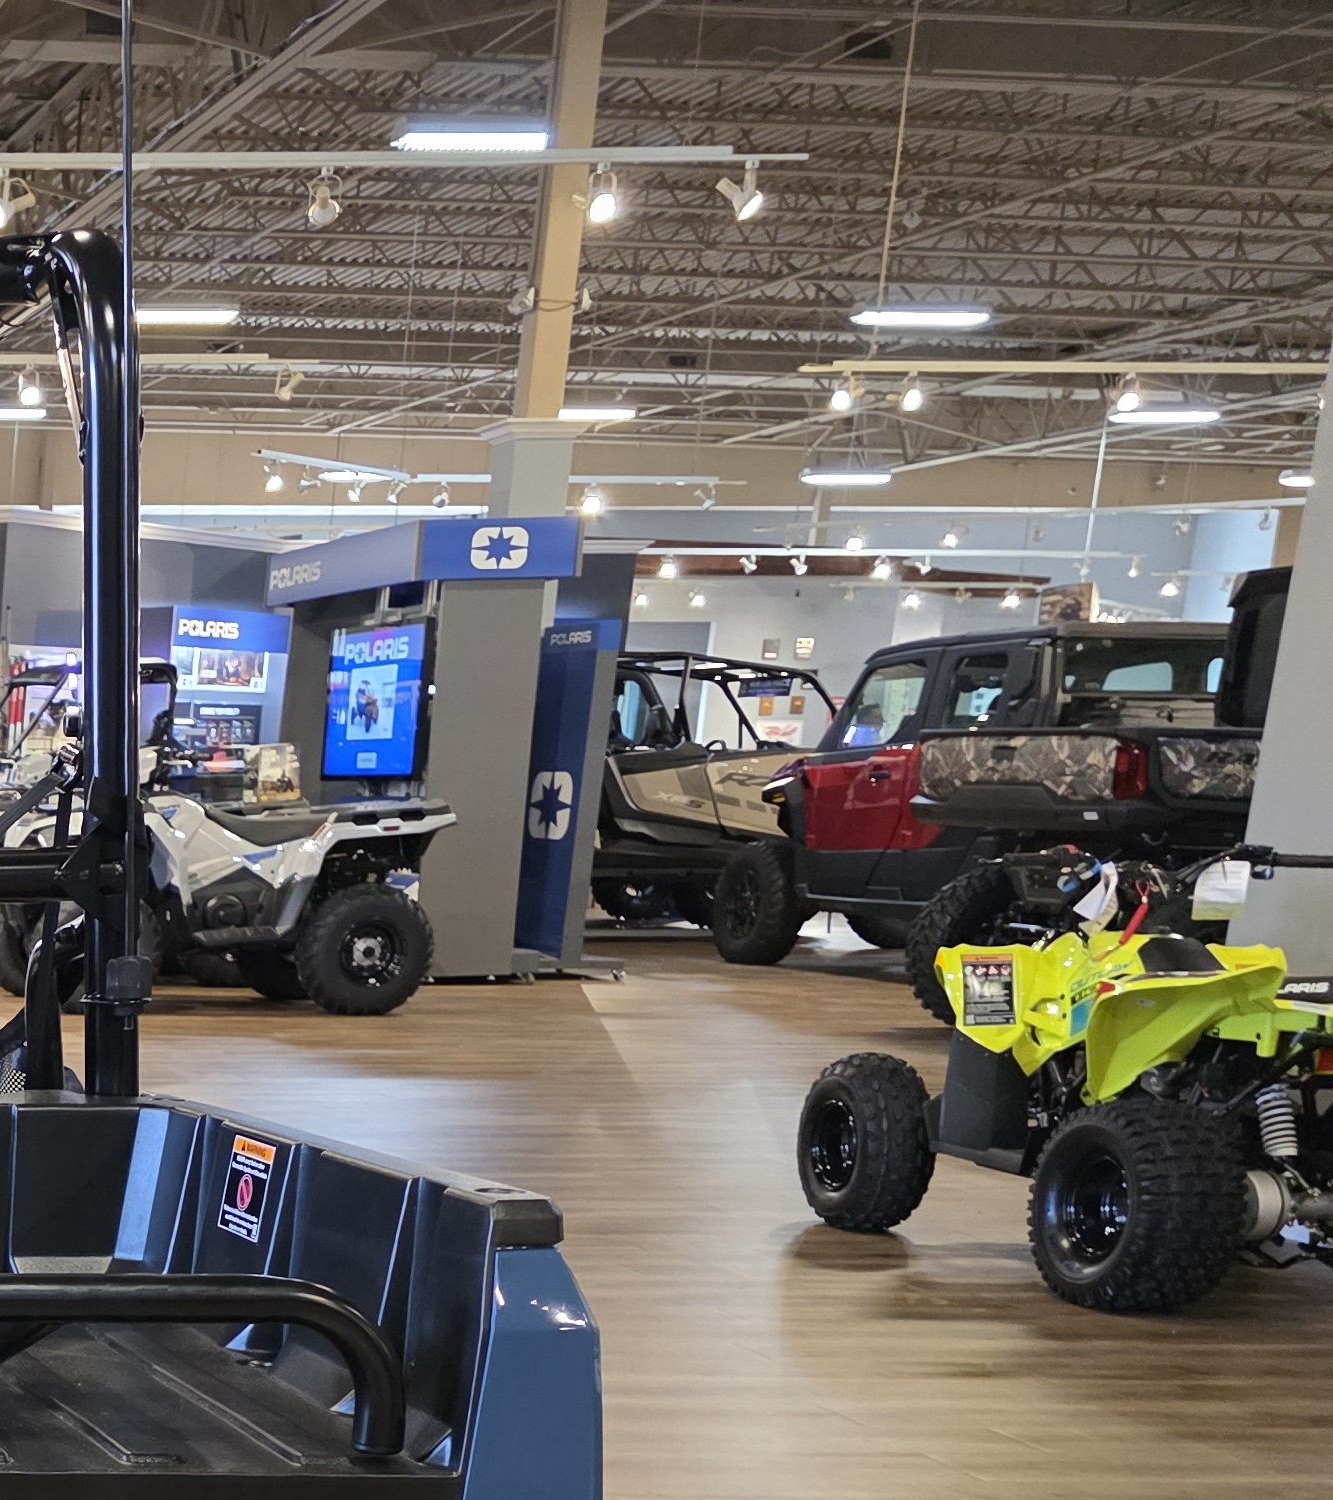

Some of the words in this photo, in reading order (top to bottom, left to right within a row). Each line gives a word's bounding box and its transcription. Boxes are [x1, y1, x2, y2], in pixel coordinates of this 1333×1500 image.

[269, 561, 322, 591] POLARIS
[178, 618, 240, 640] POLARIS
[550, 630, 592, 646] POLARIS
[344, 636, 410, 665] POLARIS
